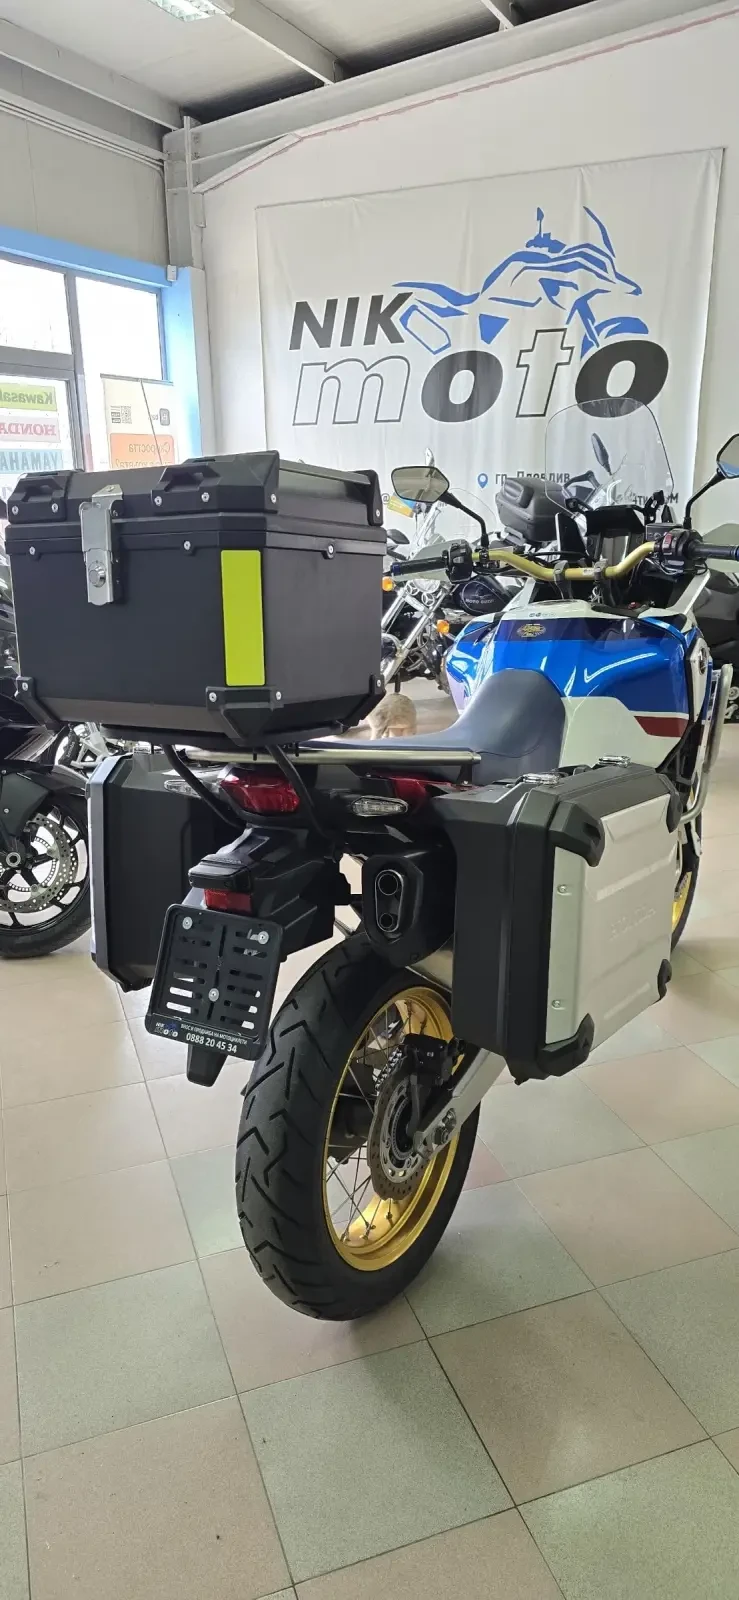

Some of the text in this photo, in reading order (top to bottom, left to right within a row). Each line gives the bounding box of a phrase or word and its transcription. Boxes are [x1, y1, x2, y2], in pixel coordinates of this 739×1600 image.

[289, 292, 414, 350] NIK
[292, 328, 669, 426] moto
[186, 1033, 237, 1053] 0888 20 45 34
